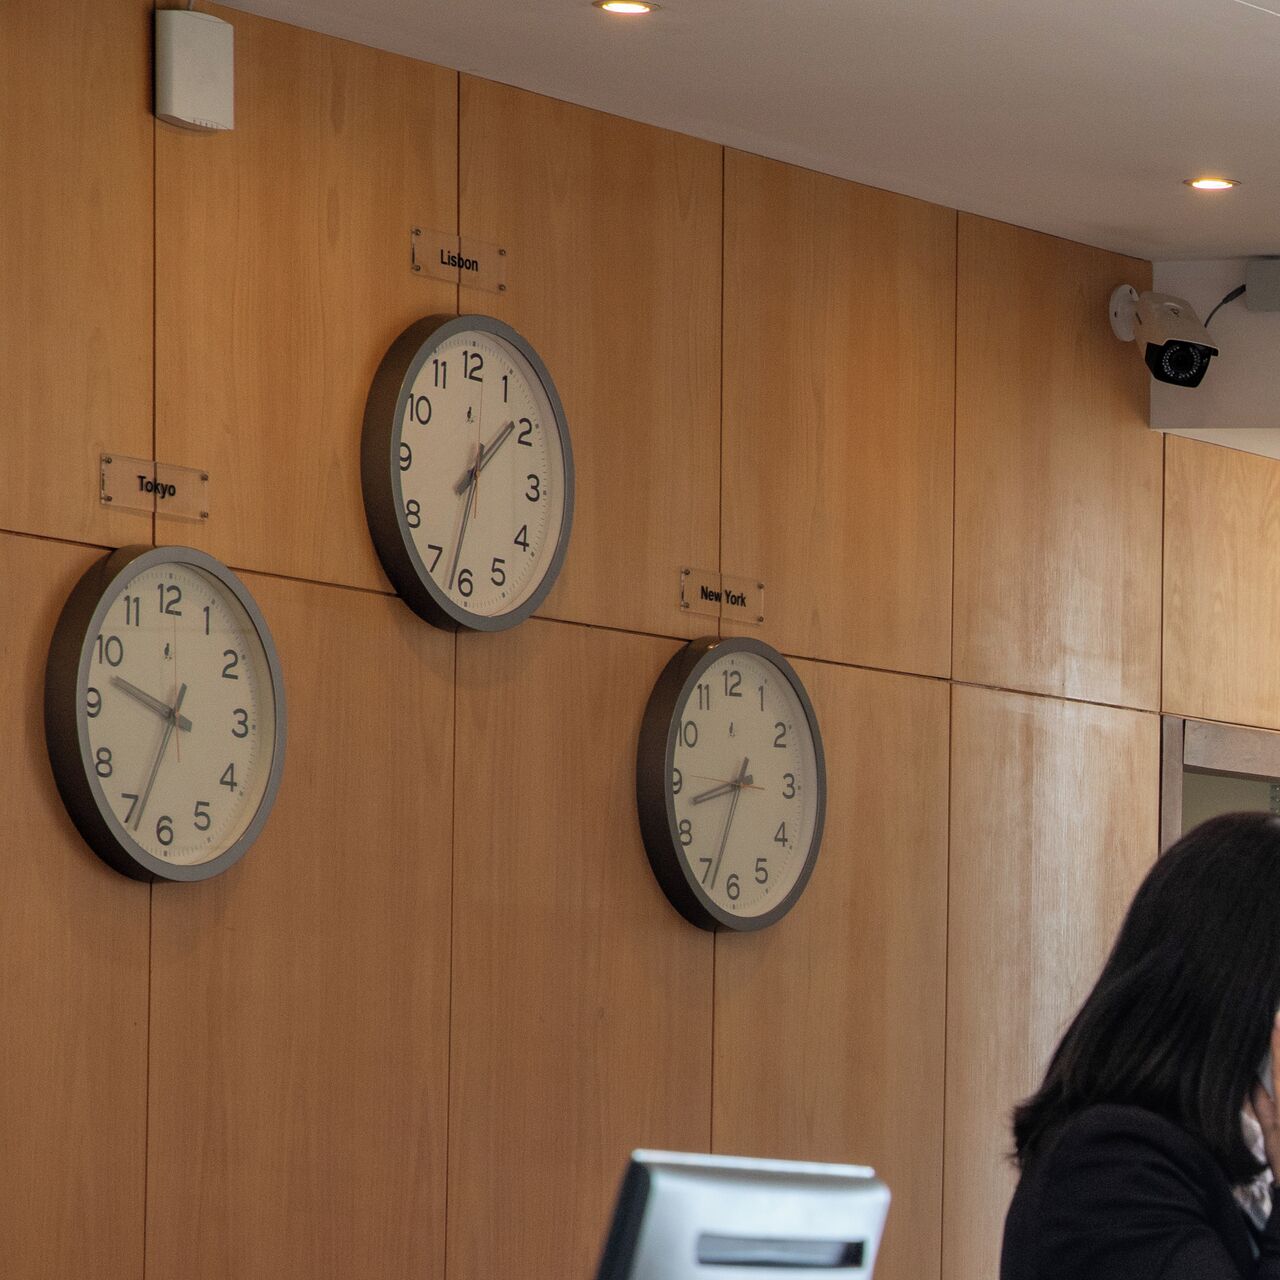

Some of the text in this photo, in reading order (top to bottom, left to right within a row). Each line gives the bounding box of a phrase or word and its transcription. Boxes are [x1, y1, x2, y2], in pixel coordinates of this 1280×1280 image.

[440, 249, 478, 272] Lisbon
[433, 359, 447, 389] 11
[462, 350, 484, 383] 12
[502, 375, 508, 403] 1
[409, 393, 432, 425] 10
[517, 417, 533, 447] 2
[400, 442, 412, 471] 9
[137, 475, 176, 499] Tokyo
[525, 474, 540, 502] 3
[405, 499, 421, 529] 8
[514, 524, 530, 552] 4
[427, 544, 443, 573] 7
[490, 558, 506, 586] 5
[457, 568, 473, 597] 6
[701, 586, 746, 607] New York
[123, 595, 140, 627] 11
[157, 583, 182, 616] 12
[203, 606, 210, 636] 1
[96, 634, 124, 667] 10
[221, 649, 239, 680] 2
[697, 683, 710, 711] 11
[722, 670, 742, 698] 12
[758, 685, 764, 712] 1
[86, 687, 102, 718] 9
[231, 708, 249, 739] 3
[679, 719, 698, 748] 10
[773, 721, 787, 748] 2
[95, 747, 113, 778] 8
[219, 762, 238, 792] 4
[672, 767, 683, 795] 9
[782, 772, 796, 800] 3
[121, 793, 139, 824] 7
[193, 800, 211, 831] 5
[155, 815, 173, 846] 6
[679, 819, 693, 847] 8
[773, 821, 788, 847] 4
[699, 857, 713, 885] 7
[755, 858, 768, 885] 5
[726, 873, 740, 900] 6
